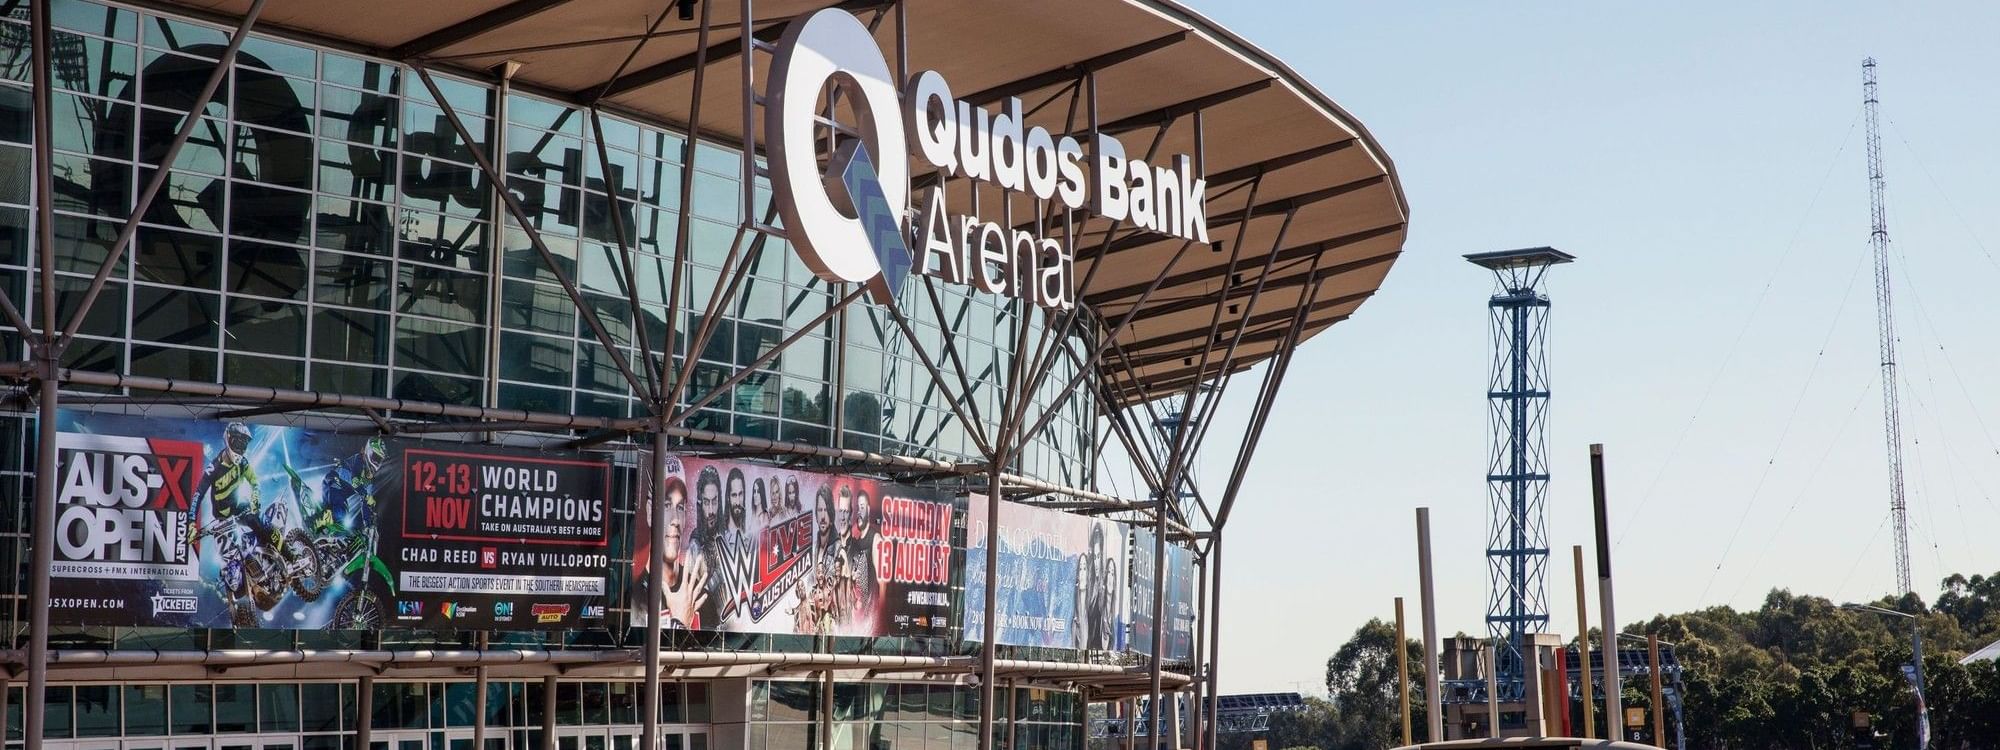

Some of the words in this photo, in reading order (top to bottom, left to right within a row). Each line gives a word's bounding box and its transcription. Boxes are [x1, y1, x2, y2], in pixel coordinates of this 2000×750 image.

[912, 70, 1086, 209] Qudos
[1098, 132, 1209, 245] Bank
[921, 186, 1075, 310] Arena
[58, 452, 189, 510] AUS-X
[412, 461, 471, 495] 12-13
[482, 465, 558, 492] WORLD
[426, 496, 470, 529] NOV
[481, 494, 603, 522] CHAMPIONS
[882, 496, 952, 542] SATURDAY
[57, 505, 177, 563] OPEN
[177, 511, 188, 563] SYDNEY
[481, 522, 499, 532] TAKE
[501, 524, 511, 532] ON
[512, 524, 557, 535] AUSTRALIA'S
[559, 526, 575, 535] BEST
[577, 526, 581, 535] &
[583, 527, 601, 536] MORE
[402, 548, 437, 563] CHAD
[444, 549, 477, 564] REED
[483, 551, 495, 565] VS
[502, 551, 535, 566] RYAN
[541, 553, 607, 568] VILLOPOTO
[752, 510, 813, 589] LIVE
[876, 540, 894, 582] 13
[894, 541, 950, 584] AUGUST
[52, 565, 103, 574] SUPERCROSS
[112, 566, 127, 575] FMX
[130, 567, 189, 576] INTERNATIONAL
[409, 575, 420, 588] THE
[422, 576, 446, 588] BIGGEST
[449, 576, 470, 589] ACTION
[472, 577, 495, 590] SPORTS
[495, 578, 514, 591] EVENT
[515, 579, 522, 591] IN
[523, 579, 533, 591] THE
[535, 579, 563, 592] SOUTHERN
[564, 580, 599, 592] HEMISPHERE
[761, 553, 812, 612] AUSTRALIA
[48, 598, 125, 609] USXOPEN.COM
[155, 597, 196, 611] TICKETEK
[1012, 613, 1028, 629] BOOK
[1029, 615, 1042, 630] NOW
[1633, 732, 1640, 741] 8
